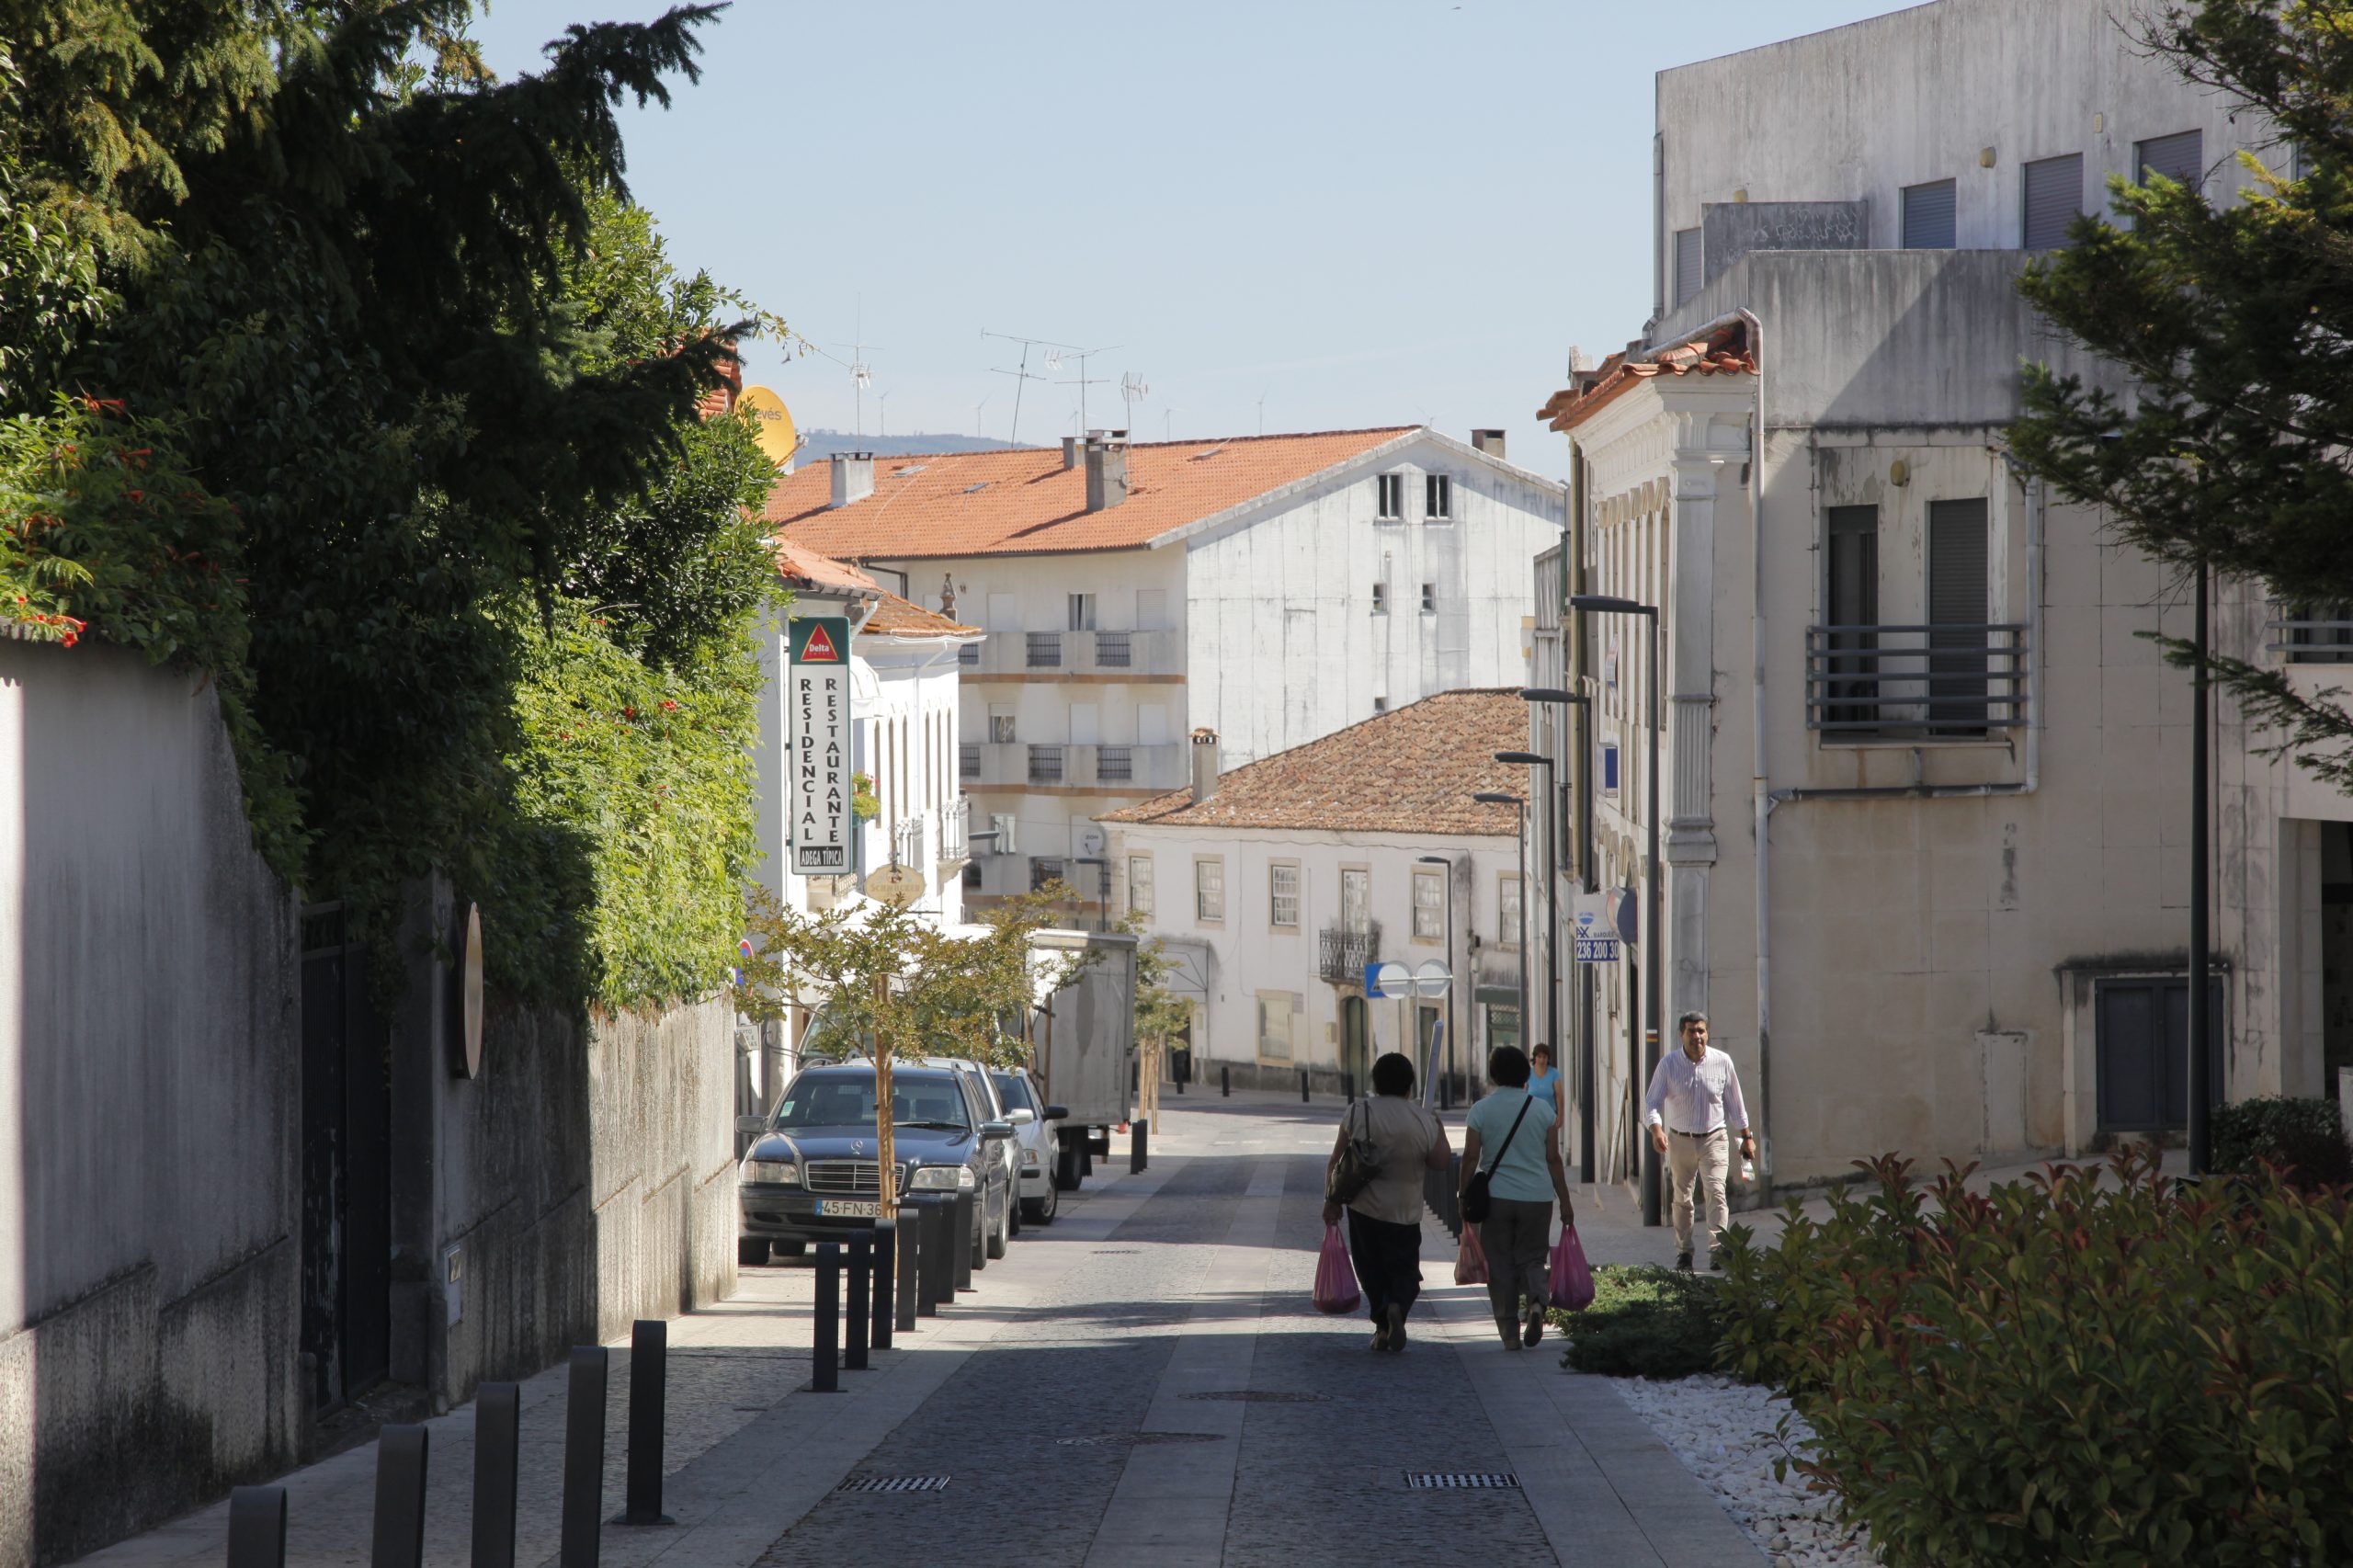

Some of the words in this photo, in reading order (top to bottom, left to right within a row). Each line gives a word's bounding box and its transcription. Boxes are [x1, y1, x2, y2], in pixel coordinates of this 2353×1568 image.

[809, 643, 830, 652] Delta
[800, 678, 816, 840] RESIDENCIAL
[825, 678, 841, 843] RESTAURANTE
[801, 850, 822, 866] ADEGA
[822, 846, 843, 866] TÍPICA
[1576, 940, 1592, 959] 236
[1593, 940, 1608, 959] 200
